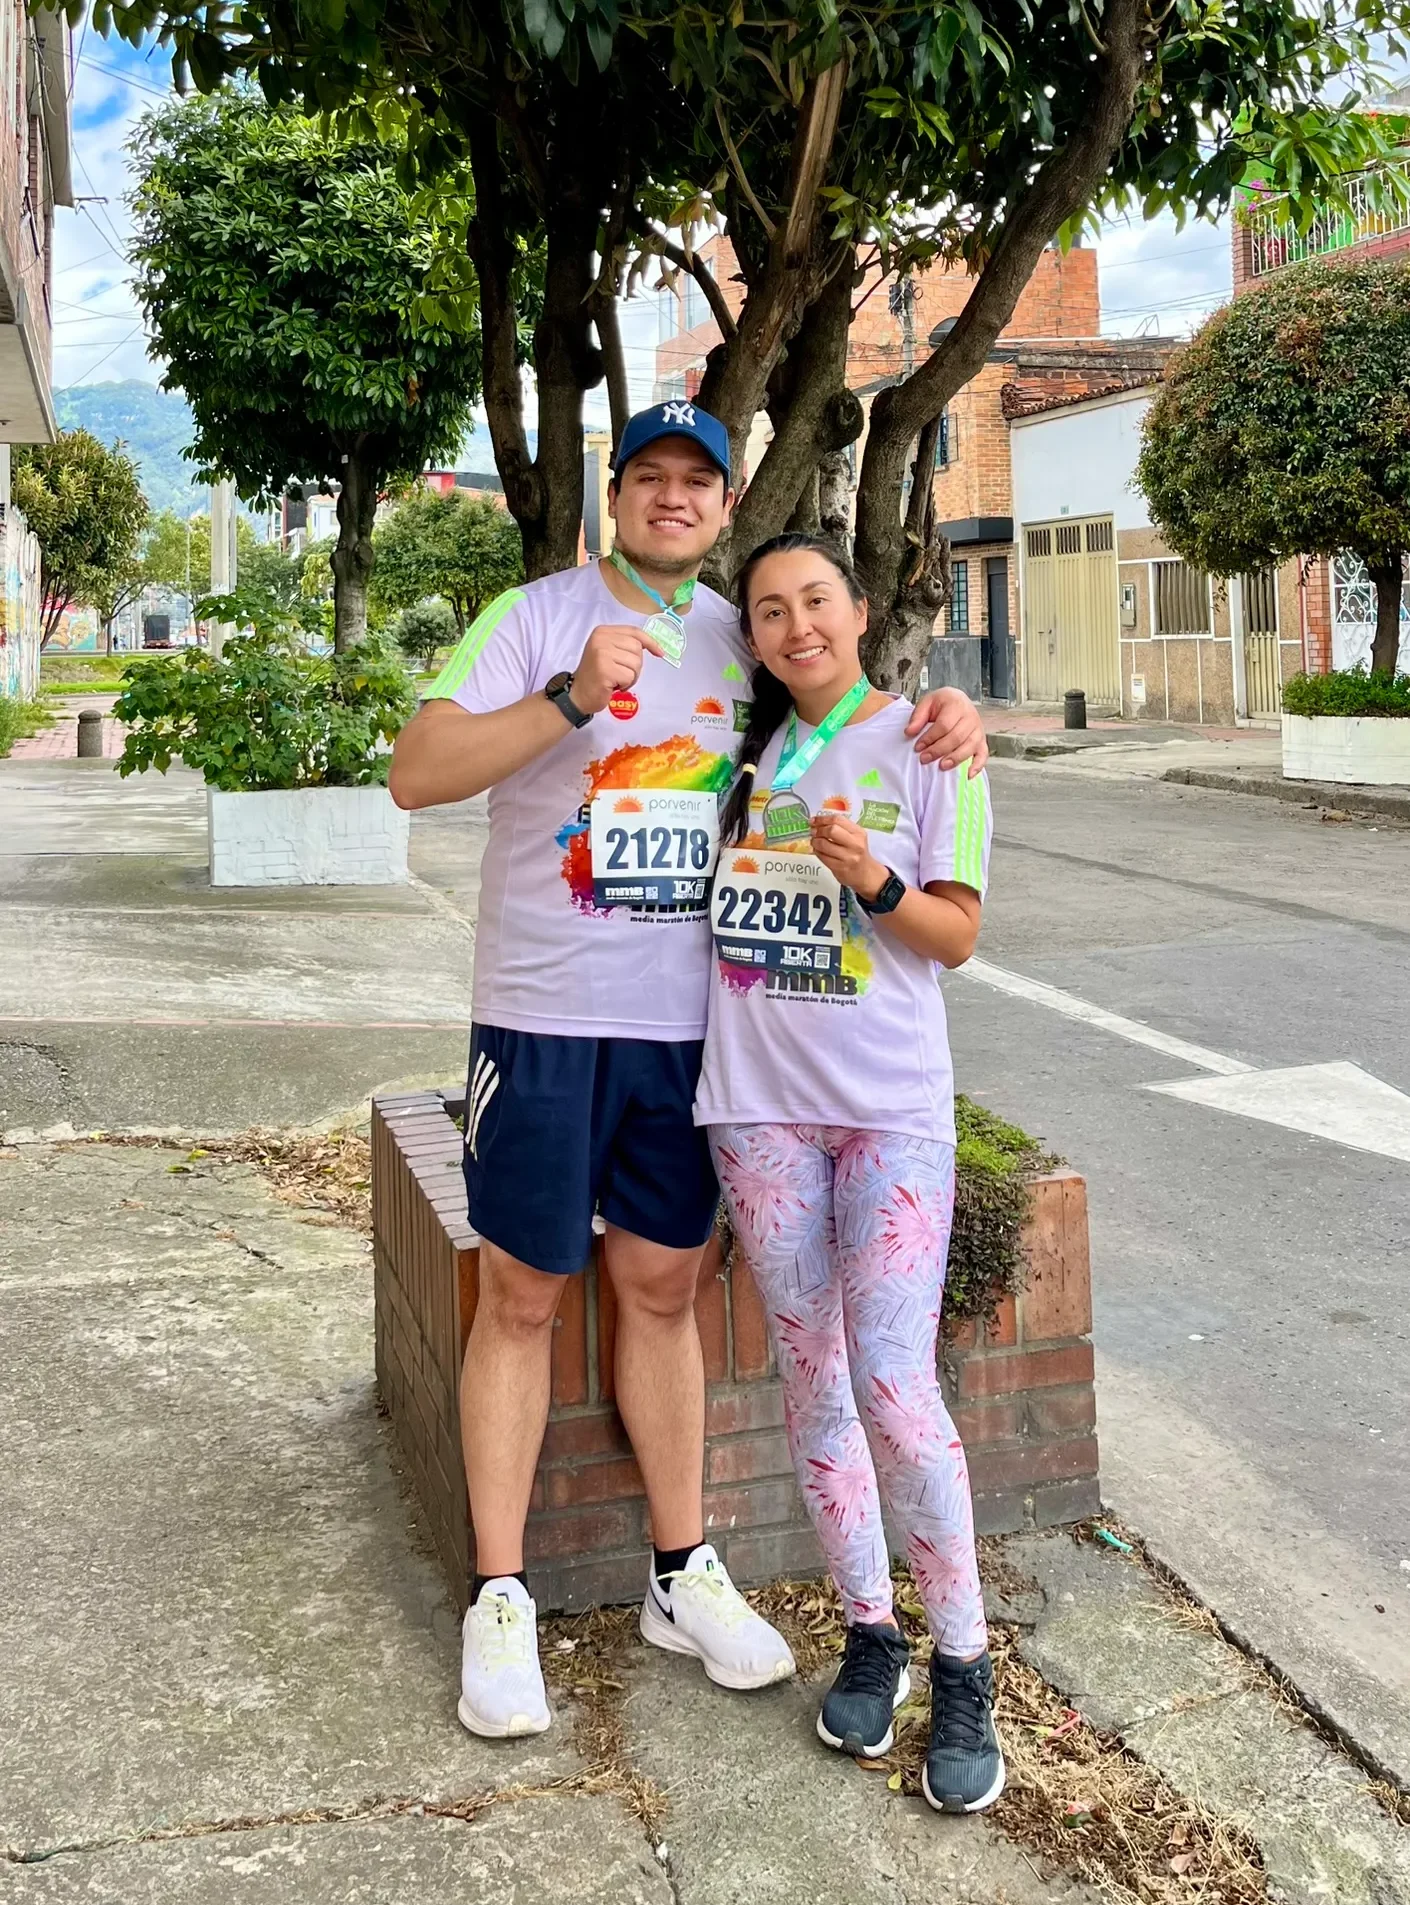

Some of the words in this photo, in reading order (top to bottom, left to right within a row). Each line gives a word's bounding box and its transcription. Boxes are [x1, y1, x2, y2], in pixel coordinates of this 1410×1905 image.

[662, 402, 696, 427] NY
[609, 700, 637, 711] easy
[690, 715, 728, 725] porvenir
[648, 799, 701, 812] porvenir
[605, 826, 710, 871] 21278
[764, 861, 821, 877] porvenir
[605, 886, 644, 896] mmB
[673, 880, 697, 894] 10K
[717, 886, 834, 938] 22342
[630, 915, 655, 923] media
[656, 916, 684, 924] maratón
[685, 915, 691, 923] de
[722, 945, 753, 957] mmB
[782, 946, 813, 961] 10K
[766, 970, 858, 995] mmB
[766, 993, 786, 1001] media
[788, 994, 819, 1003] maratón
[820, 996, 829, 1004] de
[831, 998, 858, 1007] Bogotá
